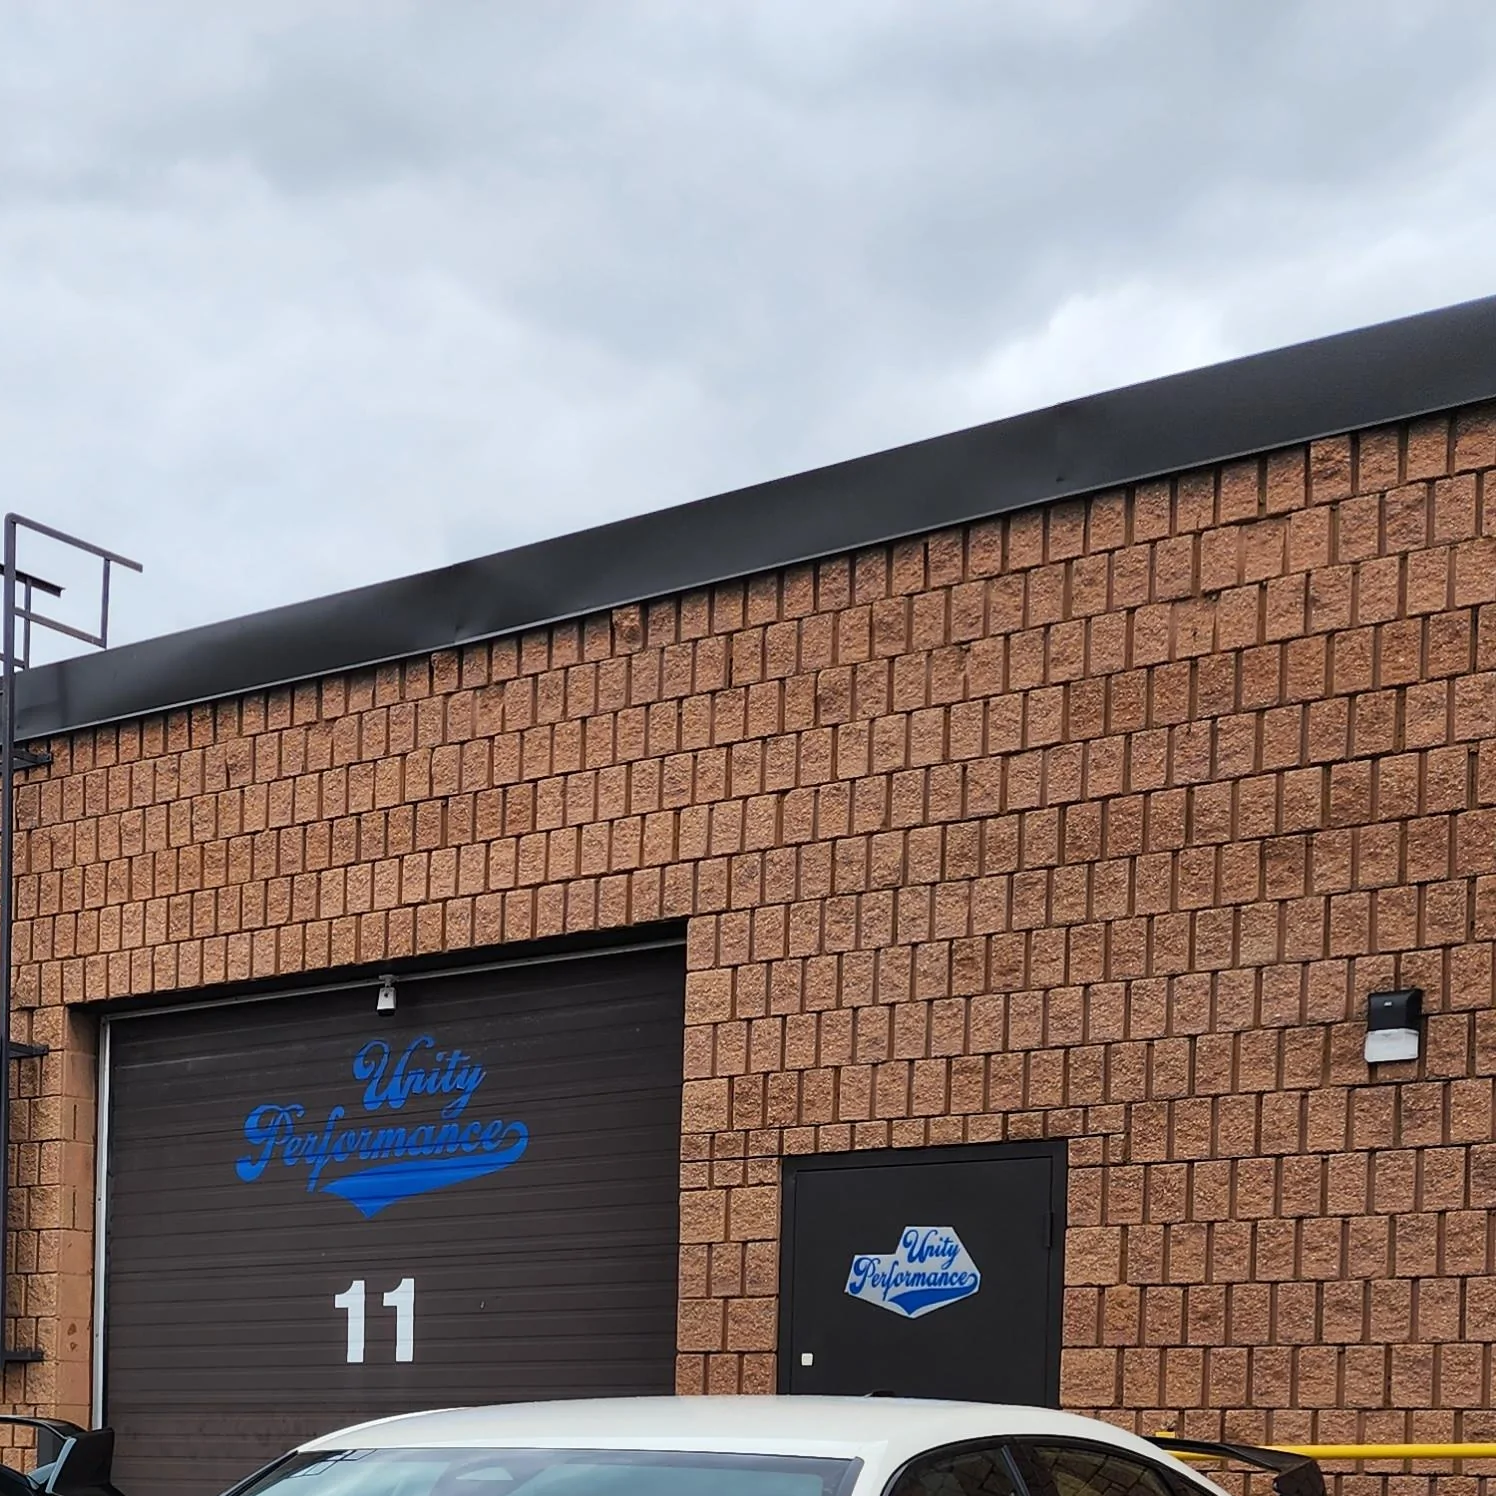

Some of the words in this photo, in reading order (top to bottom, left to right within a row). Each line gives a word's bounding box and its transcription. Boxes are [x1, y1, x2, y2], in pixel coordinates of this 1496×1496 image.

[352, 1034, 487, 1119] Unity
[234, 1103, 529, 1194] Performance
[848, 1257, 978, 1302] Performance
[902, 1229, 961, 1270] Unity
[333, 1277, 416, 1364] 11
